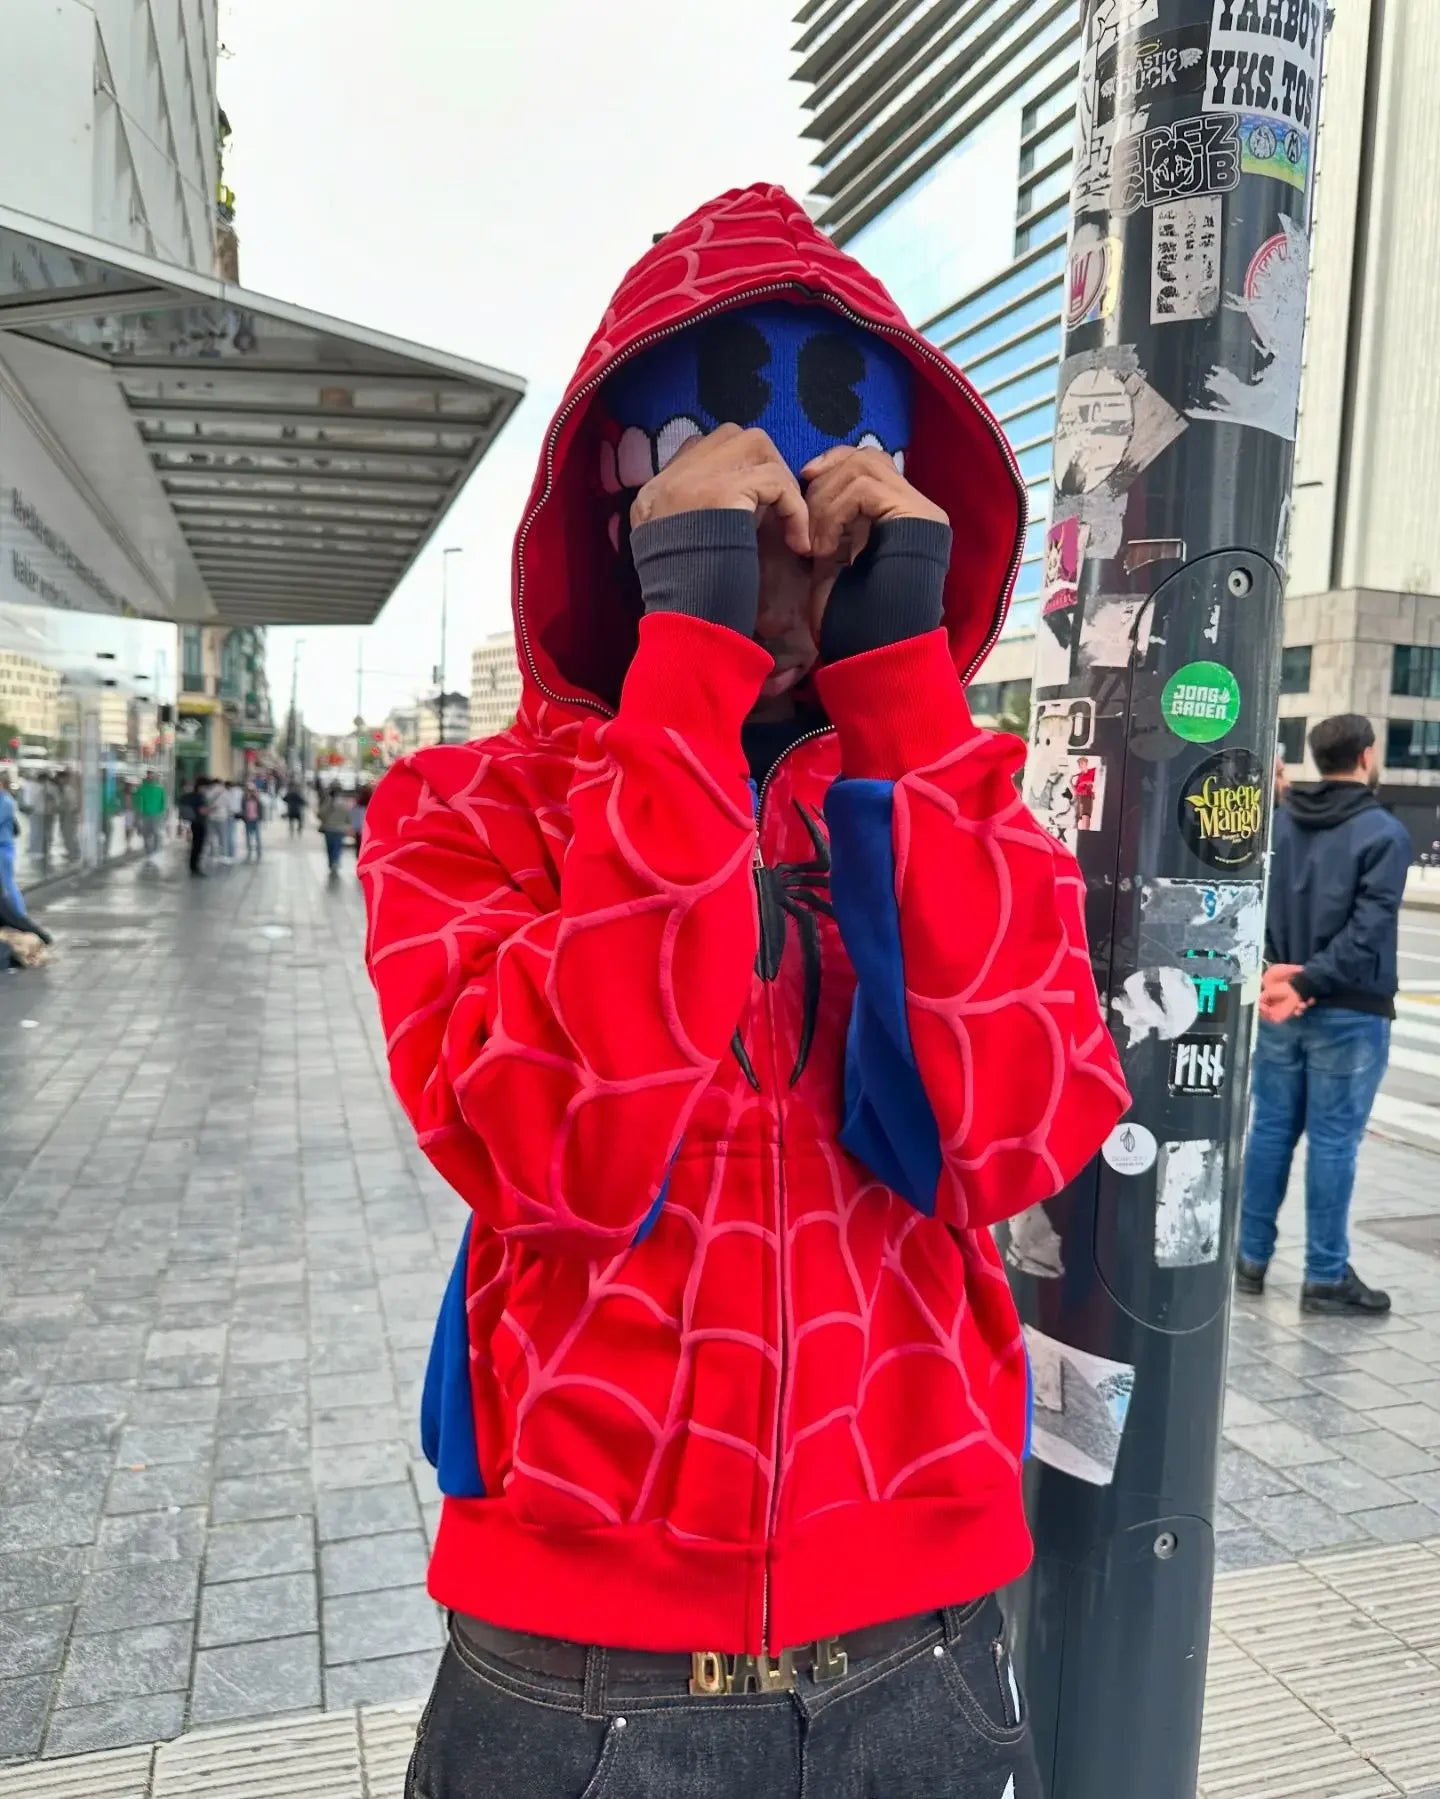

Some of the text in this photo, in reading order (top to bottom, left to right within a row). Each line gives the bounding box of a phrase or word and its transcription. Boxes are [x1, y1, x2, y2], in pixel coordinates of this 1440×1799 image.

[1117, 61, 1177, 99] DUCK
[1173, 685, 1220, 704] JONG
[1203, 776, 1255, 811] Green
[1194, 803, 1261, 839] Mango
